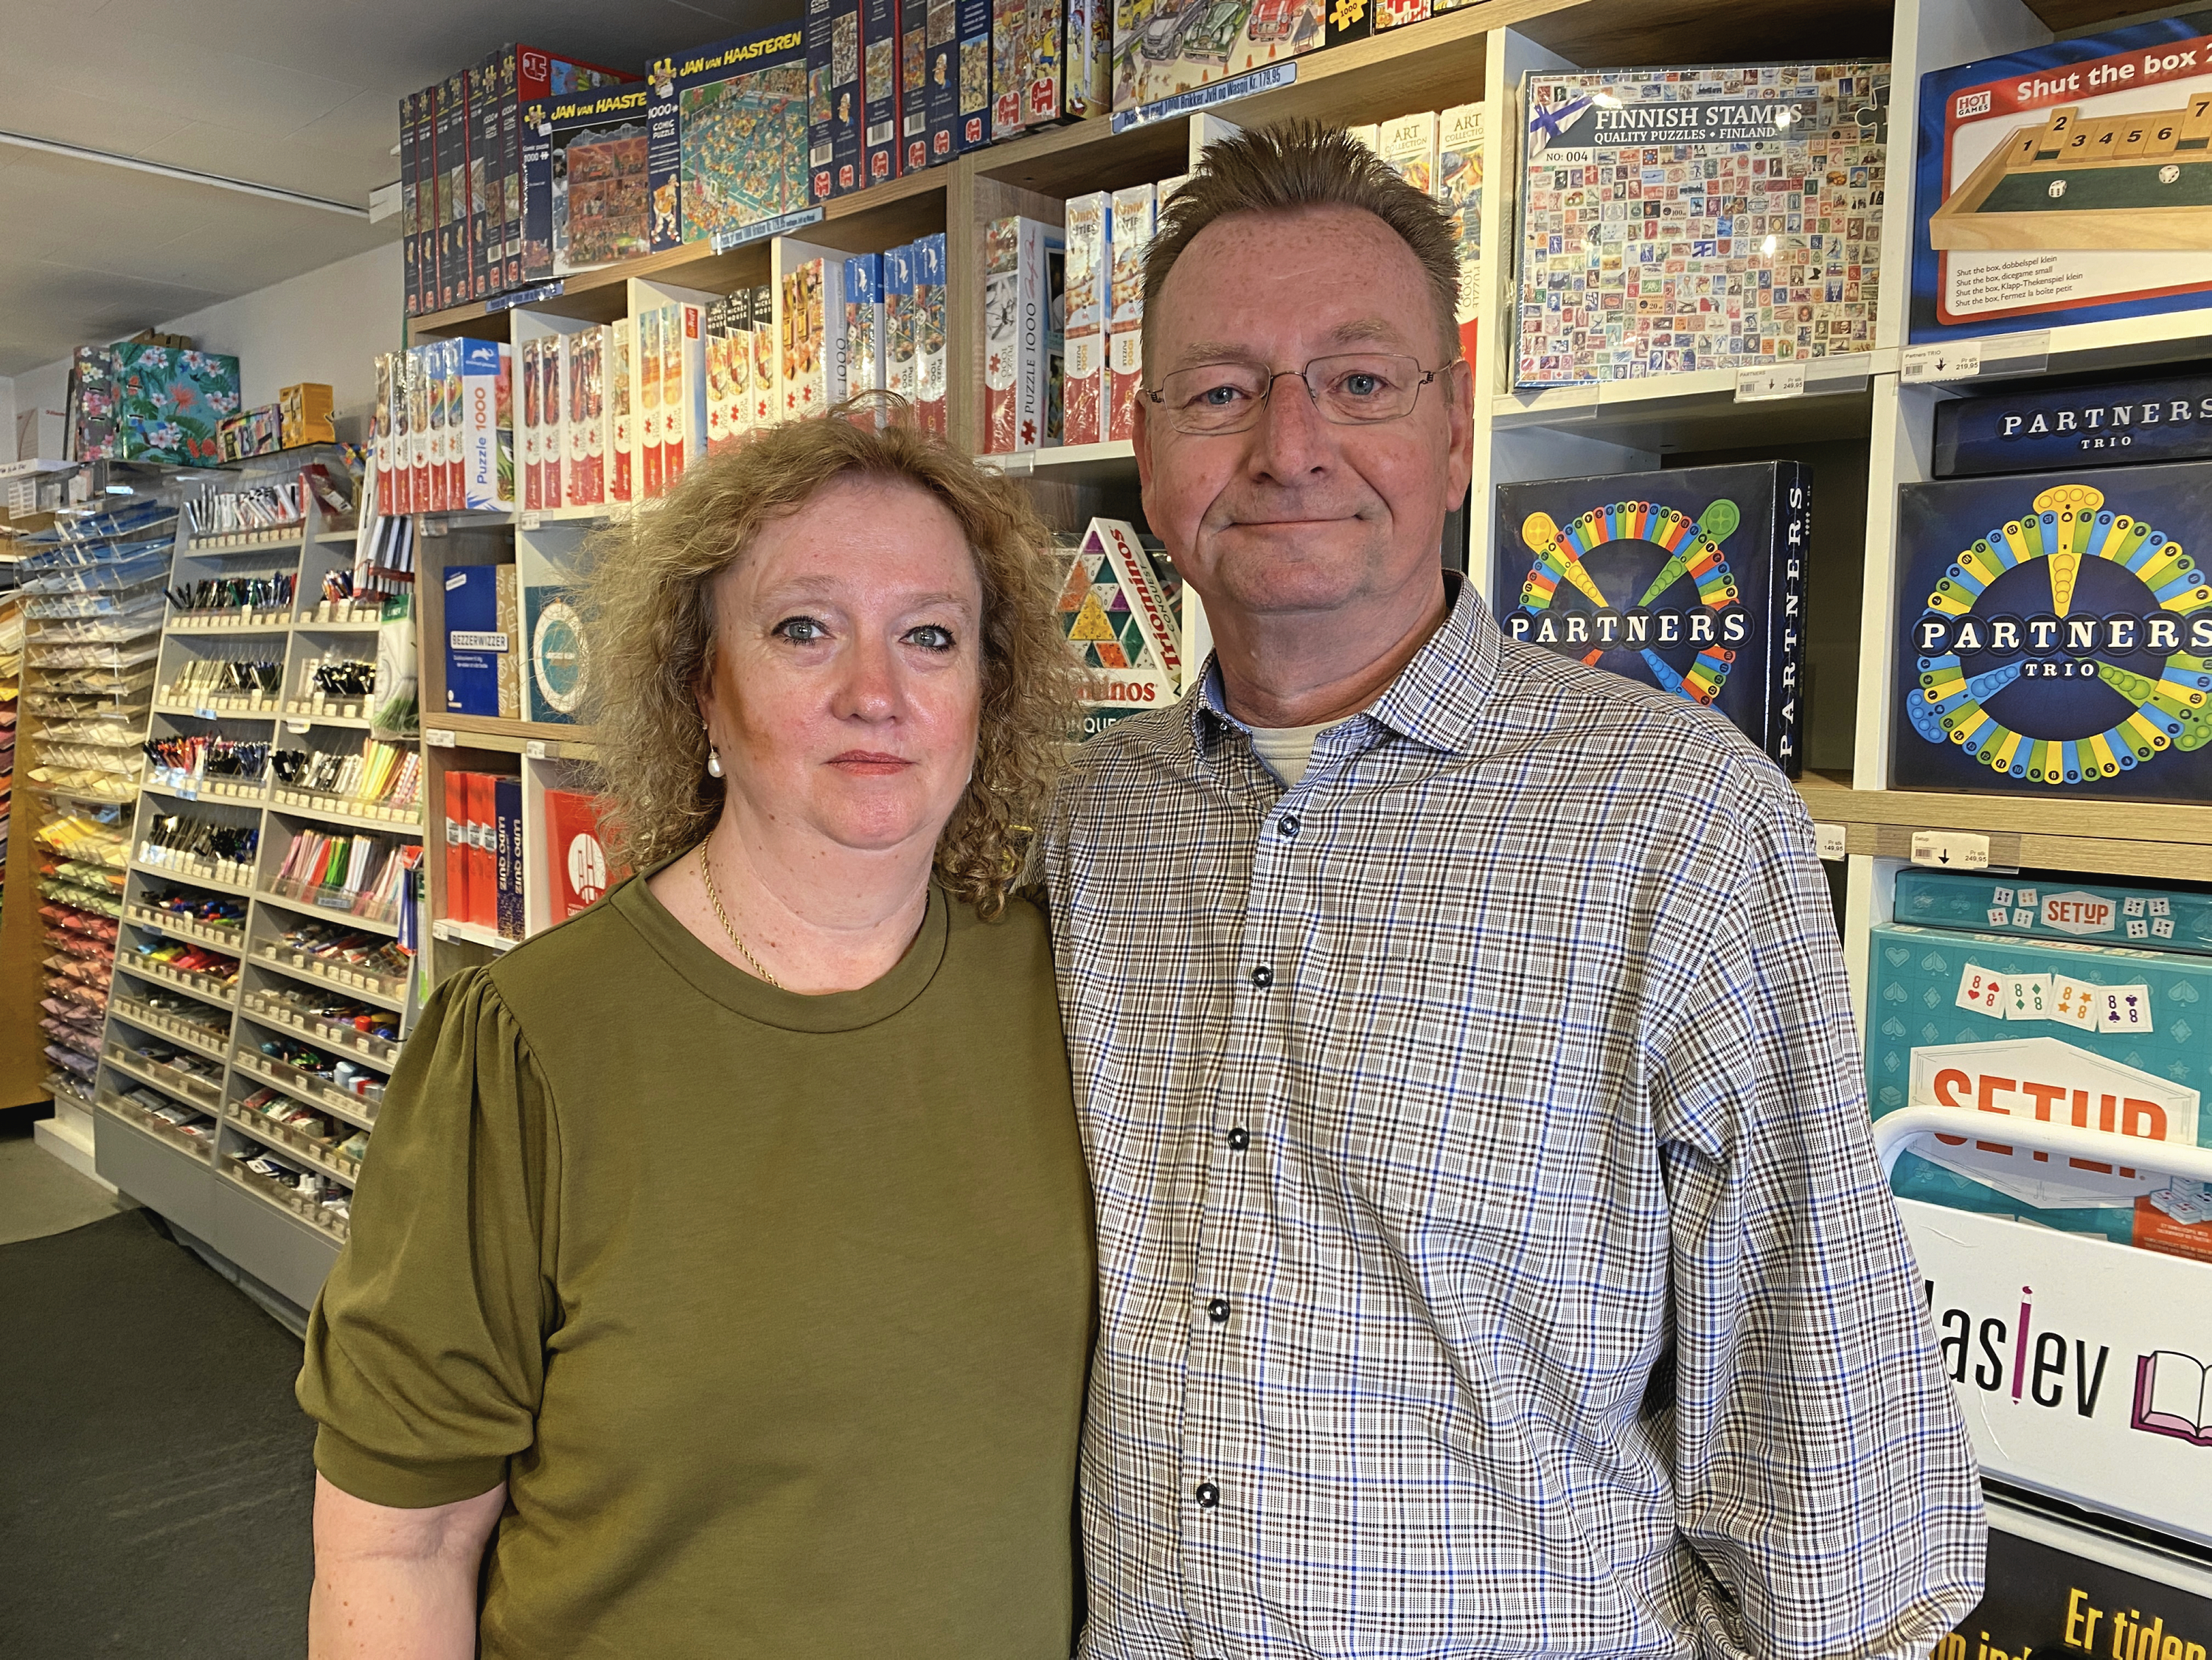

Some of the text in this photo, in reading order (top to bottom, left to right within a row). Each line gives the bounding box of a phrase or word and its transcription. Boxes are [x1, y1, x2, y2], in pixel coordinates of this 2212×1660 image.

[1340, 2, 1358, 18] 1000
[680, 31, 802, 77] JAN VAN HAASTEREN
[2017, 75, 2080, 103] Shut
[2088, 60, 2135, 86] the
[2144, 50, 2197, 74] box
[1180, 91, 1204, 108] Brikker
[1205, 88, 1217, 103] JvH
[1219, 88, 1226, 99] og
[1227, 80, 1248, 96] Wasgij
[1249, 75, 1258, 90] Kr.
[1259, 68, 1281, 86] 179,95
[1958, 104, 1988, 116] GAMES
[1959, 93, 1989, 111] HOT
[2196, 102, 2210, 117] 7
[551, 104, 575, 120] JAN
[577, 105, 594, 116] VAN
[648, 104, 672, 119] 1000
[1594, 104, 1802, 129] FINNISH STAMPS
[1454, 113, 1481, 131] ART
[2053, 117, 2067, 131] 2
[653, 128, 675, 139] PUZZLE
[1394, 125, 1419, 142] ART
[1594, 127, 1775, 144] QUALITY PUZZLES FINLAND
[2023, 128, 2172, 151] 1 3 4 5 6
[1385, 137, 1427, 152] COLLECTION
[1545, 151, 1589, 162] NO: 004
[1073, 224, 1096, 235] ITIES
[1986, 264, 2000, 272] box,
[2003, 257, 2039, 270] dobbelspel
[2041, 255, 2057, 264] klein
[1986, 274, 2000, 282] box,
[2002, 271, 2033, 280] dicegame
[2035, 266, 2053, 275] small
[2001, 275, 2065, 291] Klapp-Thekenspiel
[2066, 273, 2083, 281] klein
[1461, 268, 1472, 308] 1000
[2001, 292, 2026, 301] Fermez
[2037, 287, 2053, 296] boîte
[2056, 285, 2073, 294] petit
[1025, 302, 1036, 353] 1000
[836, 338, 847, 381] 1000
[1956, 362, 1978, 370] 219,95
[1025, 359, 1036, 414] PUZZLE
[2003, 398, 2212, 436] PARTNERS
[475, 387, 487, 485] Puzzle 1000
[2081, 436, 2132, 450] TRIO
[1108, 528, 1182, 671] Triominos
[1140, 564, 1176, 633] CONQUEST
[1511, 614, 1745, 643] PARTNERS
[1778, 486, 1803, 758] PARTNERS
[453, 635, 506, 647] BEZZERWIZZER
[1921, 619, 2212, 649] PARTNERS
[2025, 663, 2095, 678] TRIO
[513, 819, 523, 895] LUDO QUIZ
[498, 856, 507, 891] QUIZ
[2048, 900, 2109, 925] SETUP
[1972, 976, 1982, 990] 8
[2014, 984, 2023, 997] 8
[1986, 993, 1995, 1006] 8
[2063, 987, 2073, 1000] 8
[2034, 996, 2042, 1010] 8
[2107, 996, 2116, 1009] 8
[2077, 1006, 2087, 1019] 8
[2129, 1009, 2138, 1022] 8
[1933, 1068, 2168, 1179] SETUP
[2065, 1588, 2104, 1650] Er
